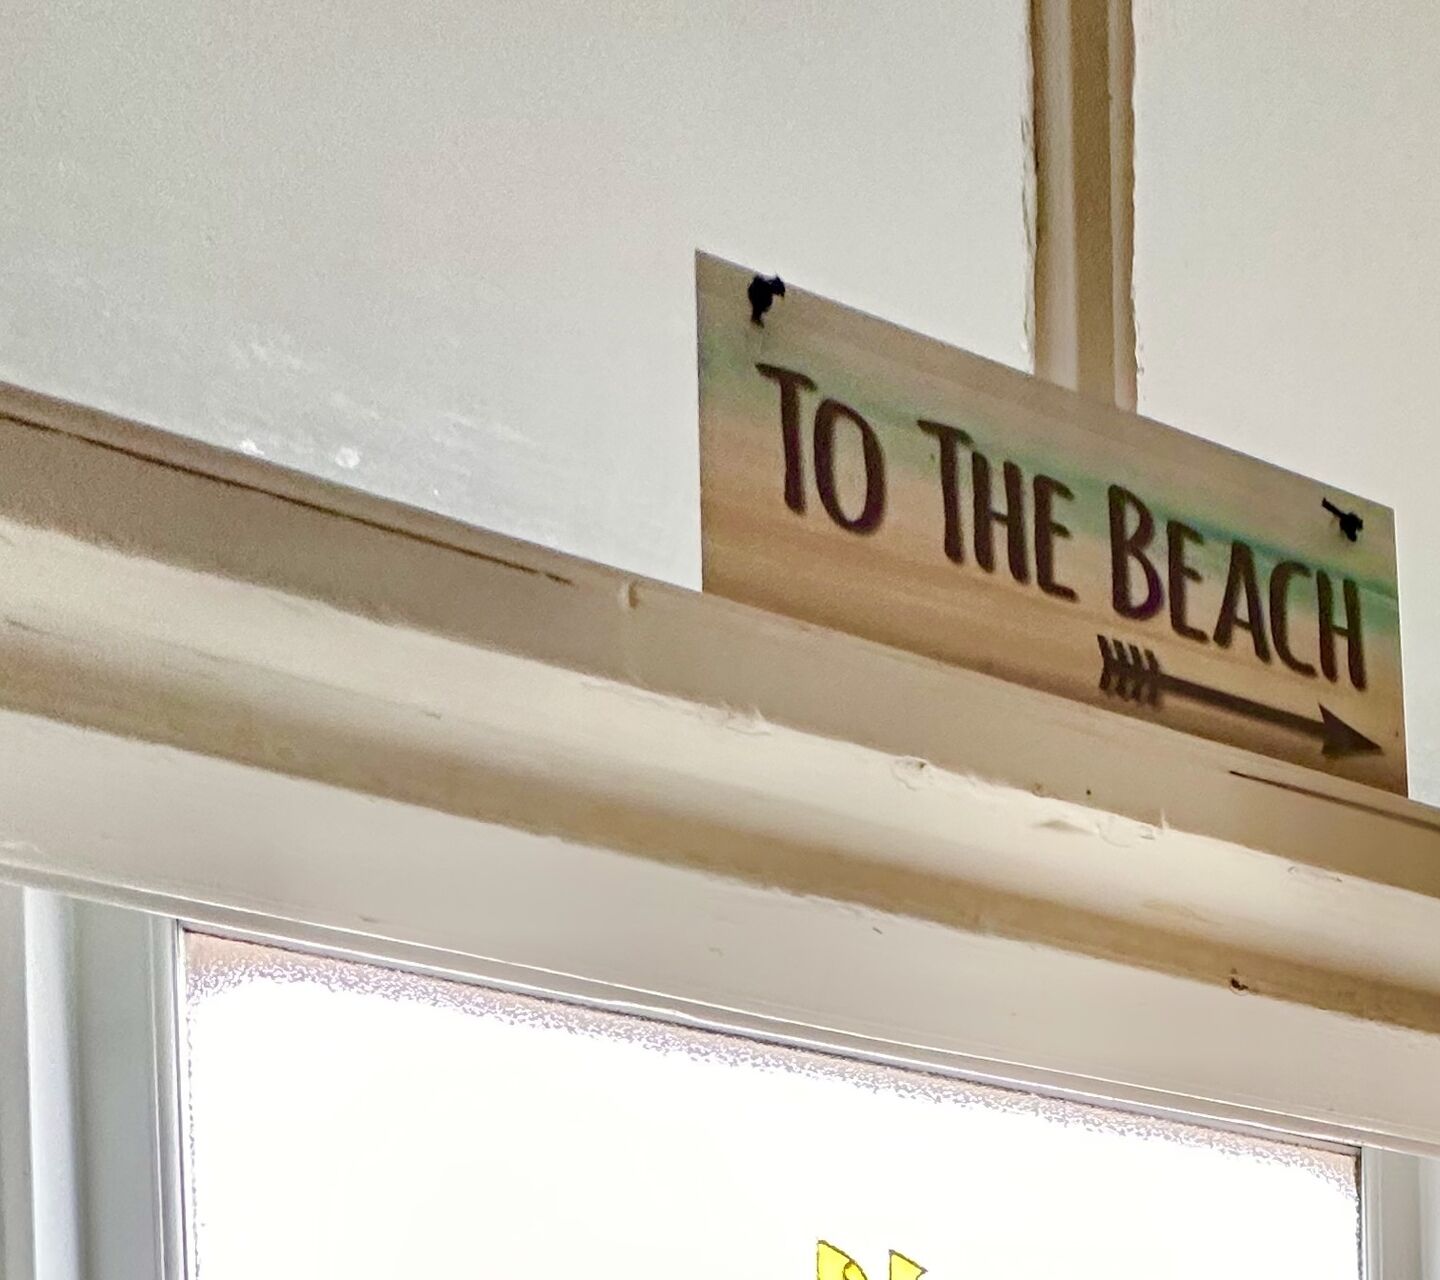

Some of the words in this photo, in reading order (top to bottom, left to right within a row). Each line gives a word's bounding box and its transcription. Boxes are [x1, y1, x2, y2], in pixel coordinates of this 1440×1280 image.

[756, 362, 888, 536] TO
[917, 418, 1080, 602] THE
[1107, 484, 1367, 692] BEACH
